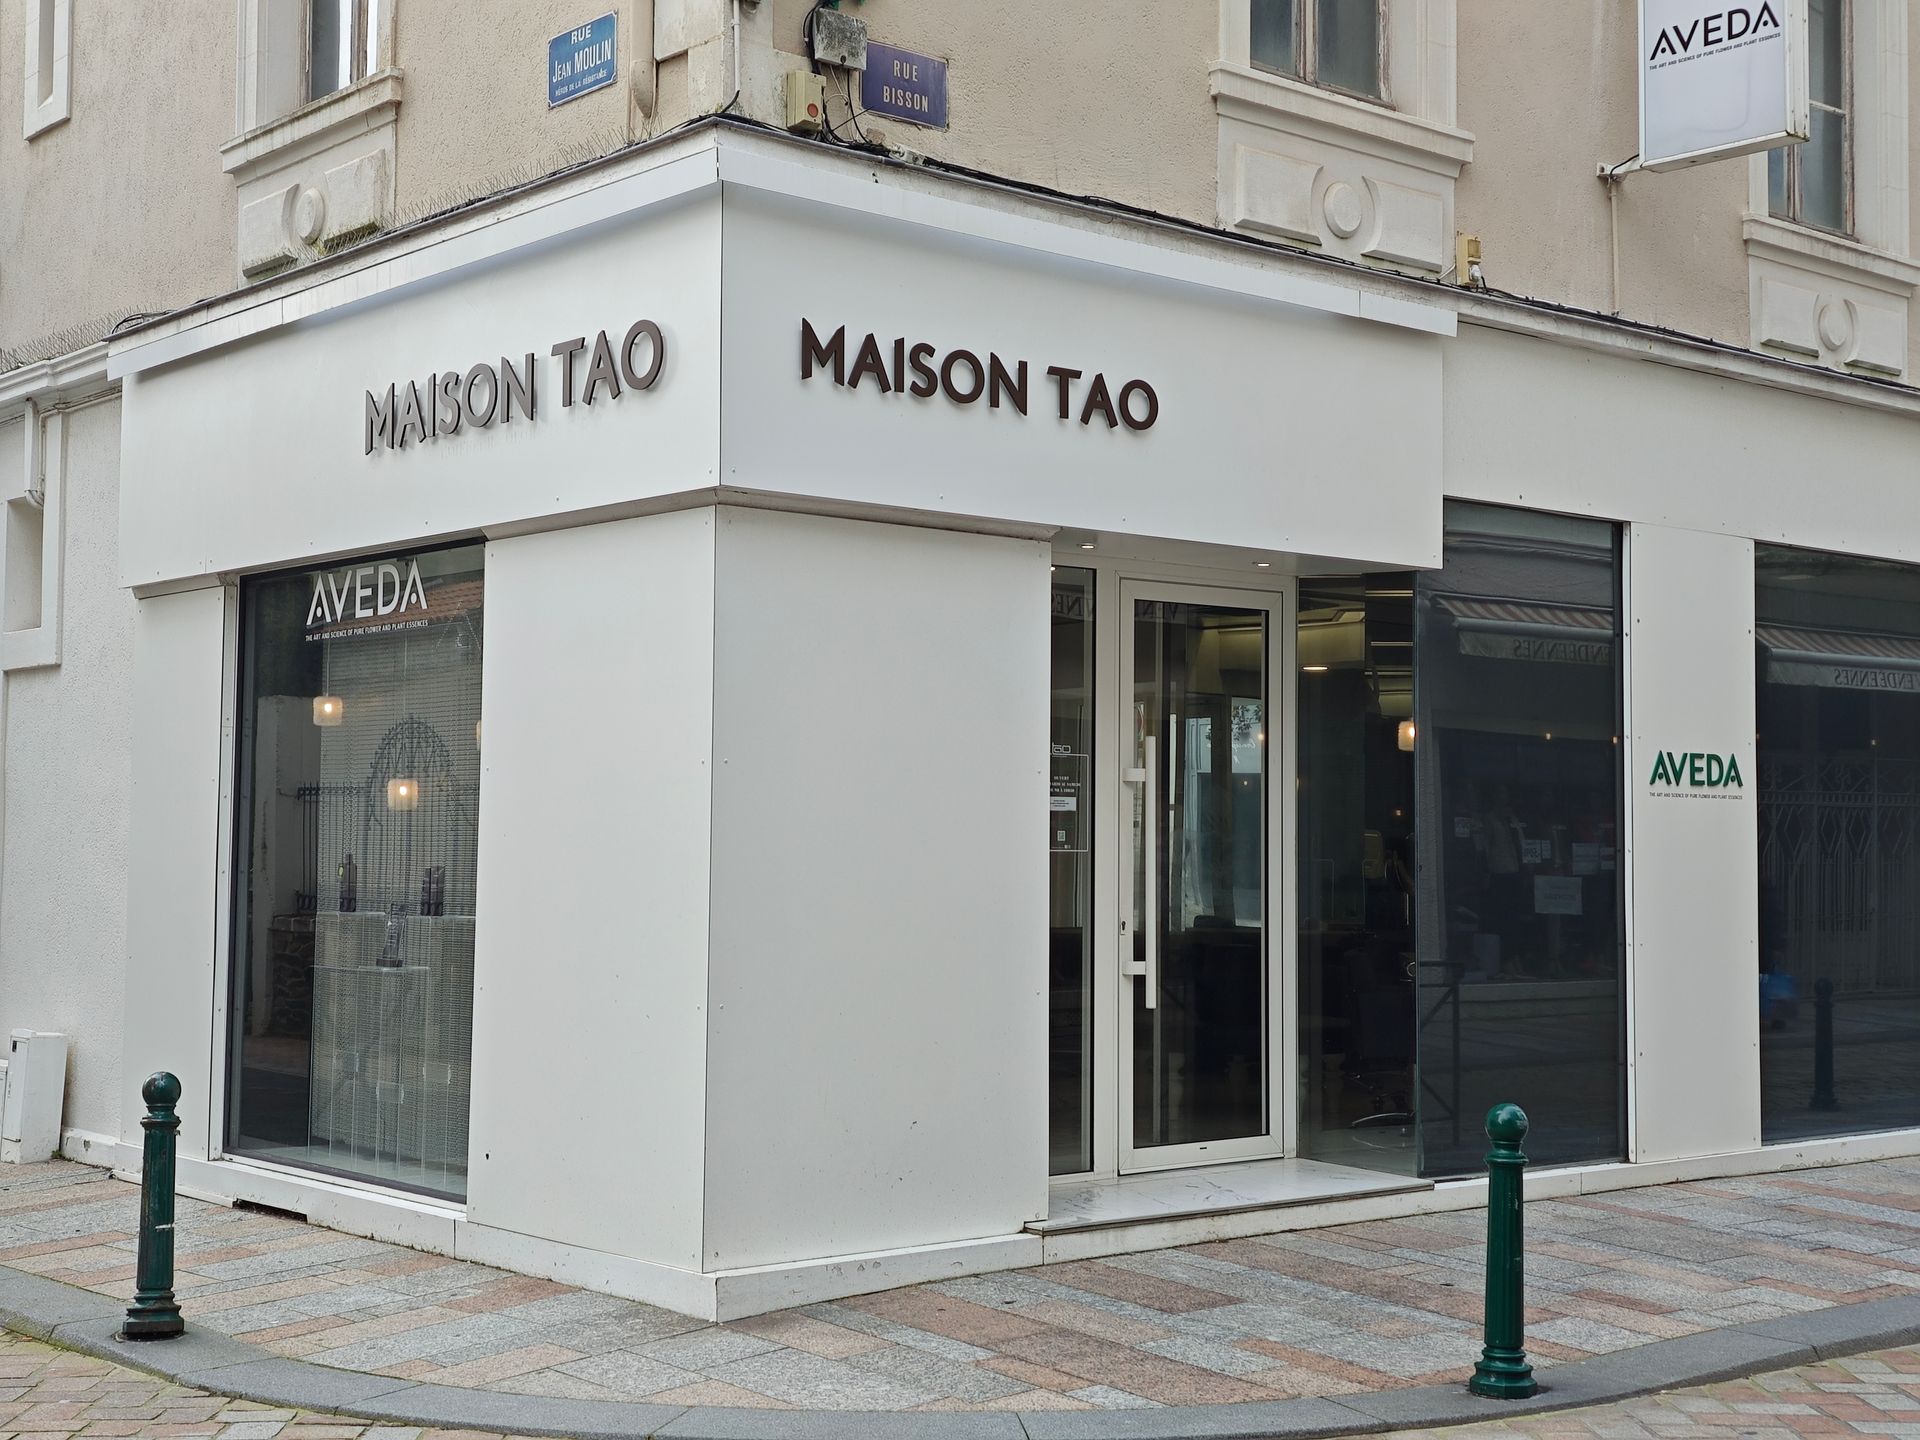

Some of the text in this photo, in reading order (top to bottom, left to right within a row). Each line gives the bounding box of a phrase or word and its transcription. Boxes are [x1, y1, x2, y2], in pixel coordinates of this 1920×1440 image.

[571, 24, 592, 45] RUE
[1649, 0, 1780, 61] AVEDA
[574, 38, 612, 74] MOULIN
[893, 59, 918, 82] RUE
[568, 83, 575, 91] DE
[575, 81, 581, 89] LA
[883, 85, 929, 113] BISSON
[365, 319, 664, 456] MAISON TAO
[801, 317, 1159, 431] MAISON TAO
[306, 557, 428, 626] AVEDA
[1649, 750, 1743, 788] AVEDA
